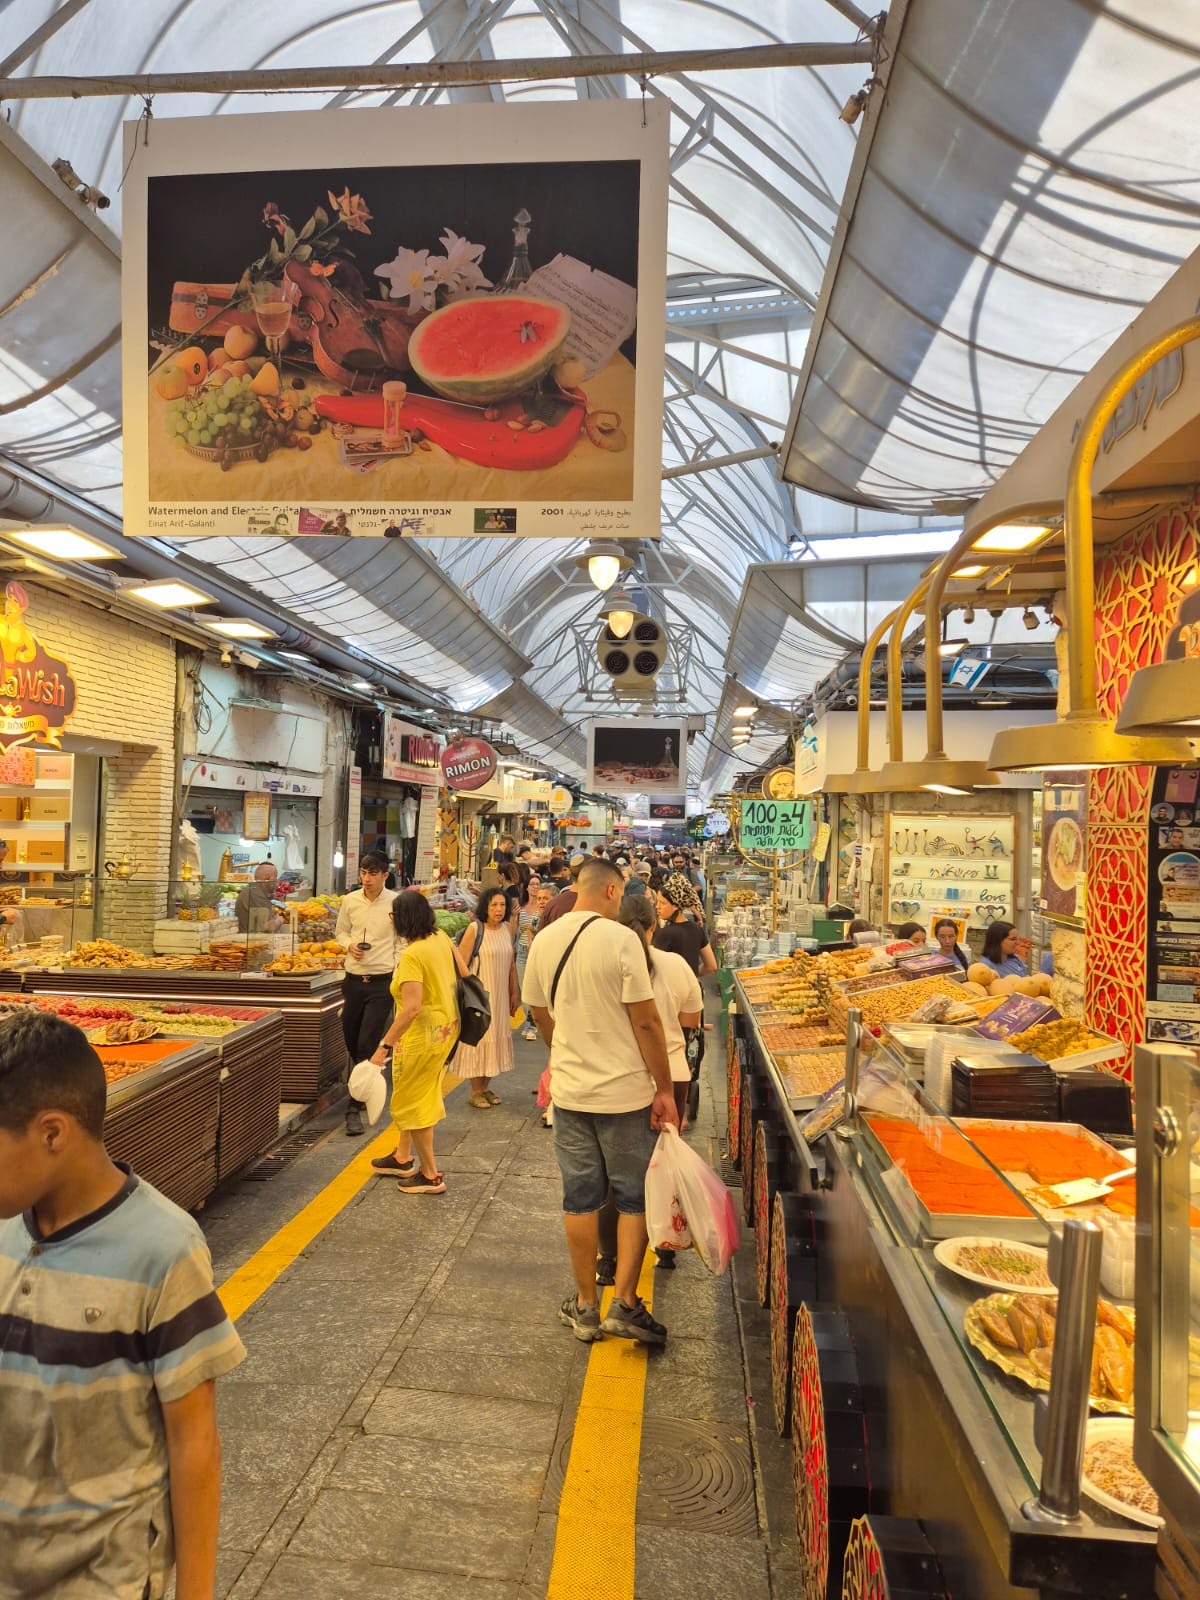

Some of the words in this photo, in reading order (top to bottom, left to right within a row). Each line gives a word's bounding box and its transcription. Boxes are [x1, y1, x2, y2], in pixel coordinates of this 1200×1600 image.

[148, 506, 209, 516] Watermelon
[213, 506, 229, 516] and
[350, 507, 386, 516] חשמלית
[389, 507, 420, 516] וגיטרה
[422, 507, 452, 516] אבטיח
[541, 508, 564, 516] 2001
[148, 519, 166, 528] Einat
[445, 756, 491, 778] RIMON
[980, 889, 1006, 901] love
